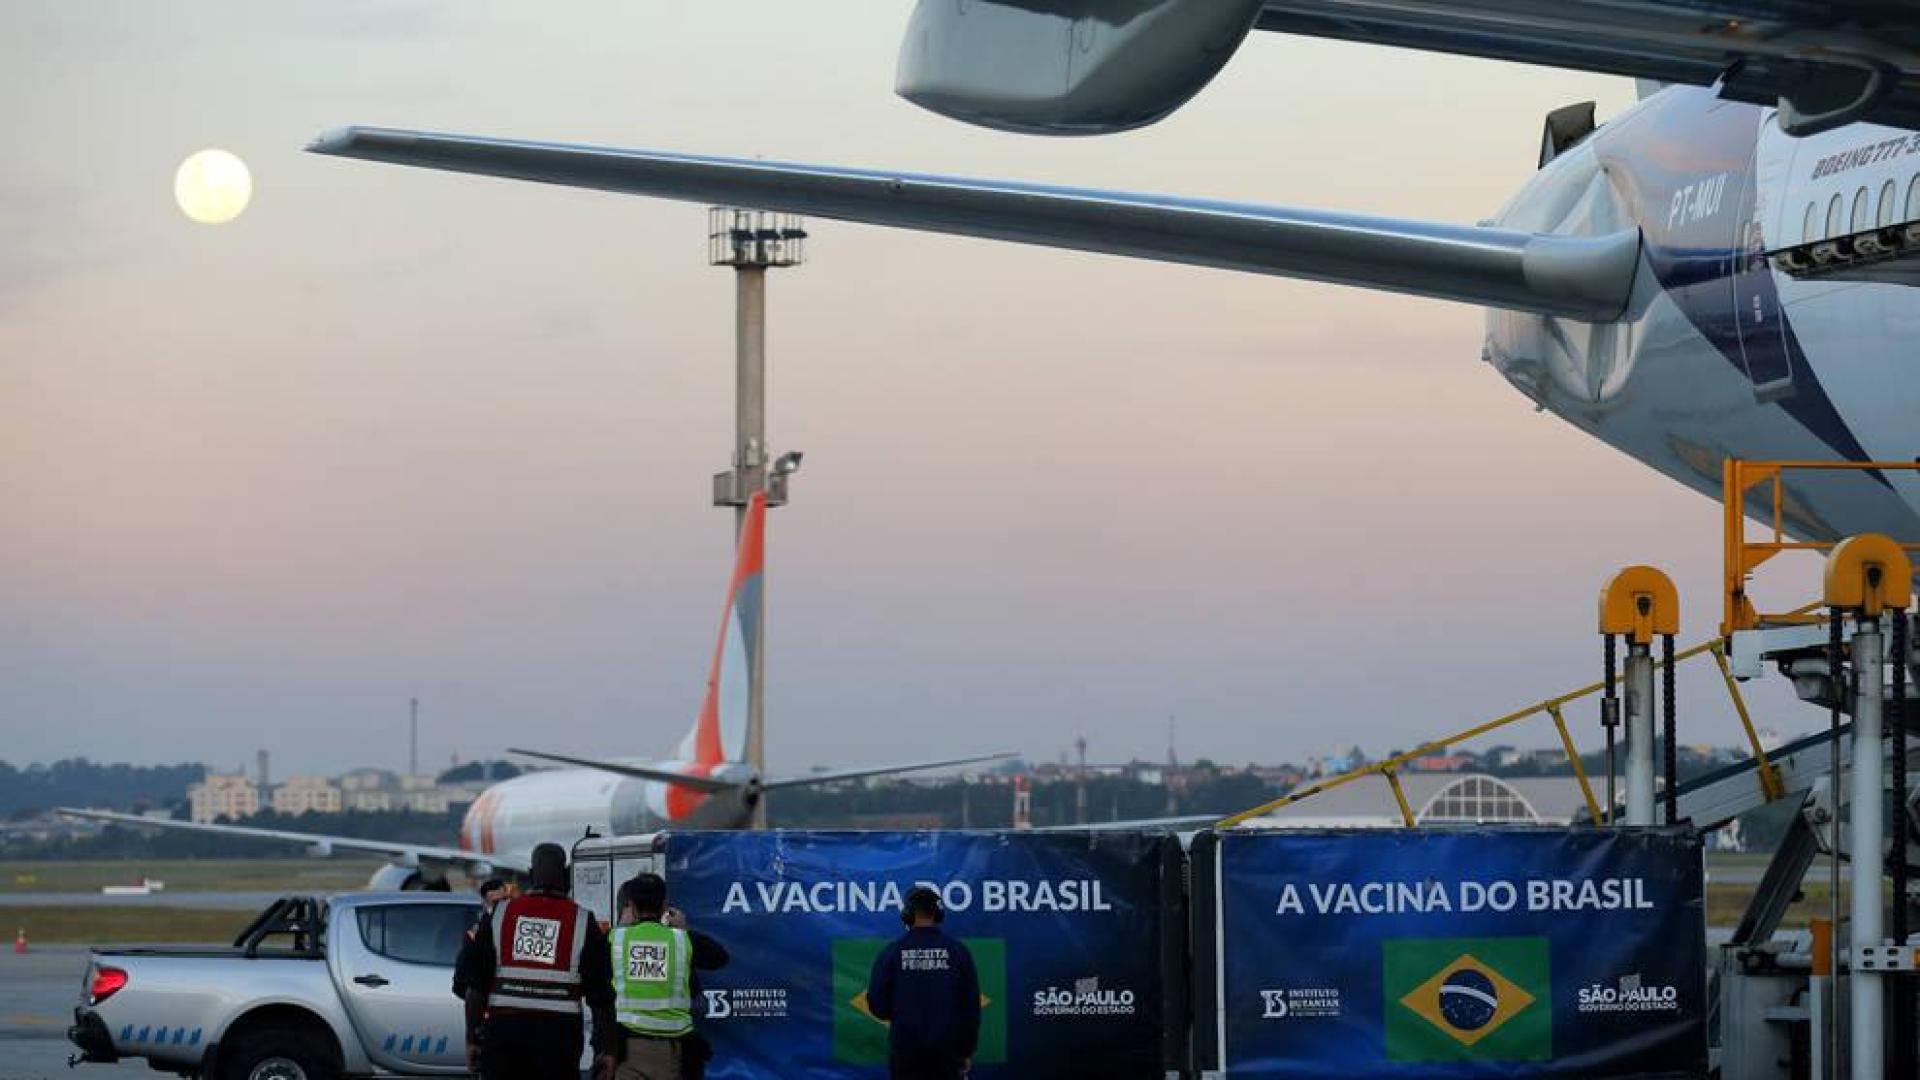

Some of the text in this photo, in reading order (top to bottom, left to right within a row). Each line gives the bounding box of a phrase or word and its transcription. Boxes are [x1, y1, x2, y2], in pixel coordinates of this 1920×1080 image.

[1811, 143, 1876, 180] BOEING
[722, 880, 752, 914] A
[756, 880, 905, 914] VACINA
[982, 879, 1111, 913] BRASIL
[1276, 877, 1653, 915] A VACINA DO BRASIL
[519, 919, 557, 941] GRU
[515, 937, 554, 959] 0302
[629, 944, 666, 961] GRU
[901, 949, 949, 959] RECEITA
[629, 960, 666, 979] 27MK
[901, 959, 950, 970] FEDERAL
[732, 988, 787, 998] INSTITUTO
[1034, 986, 1134, 1006] SÃO PAULO
[1578, 984, 1677, 1003] SÃO PAULO
[732, 999, 787, 1009] BUTANTAN
